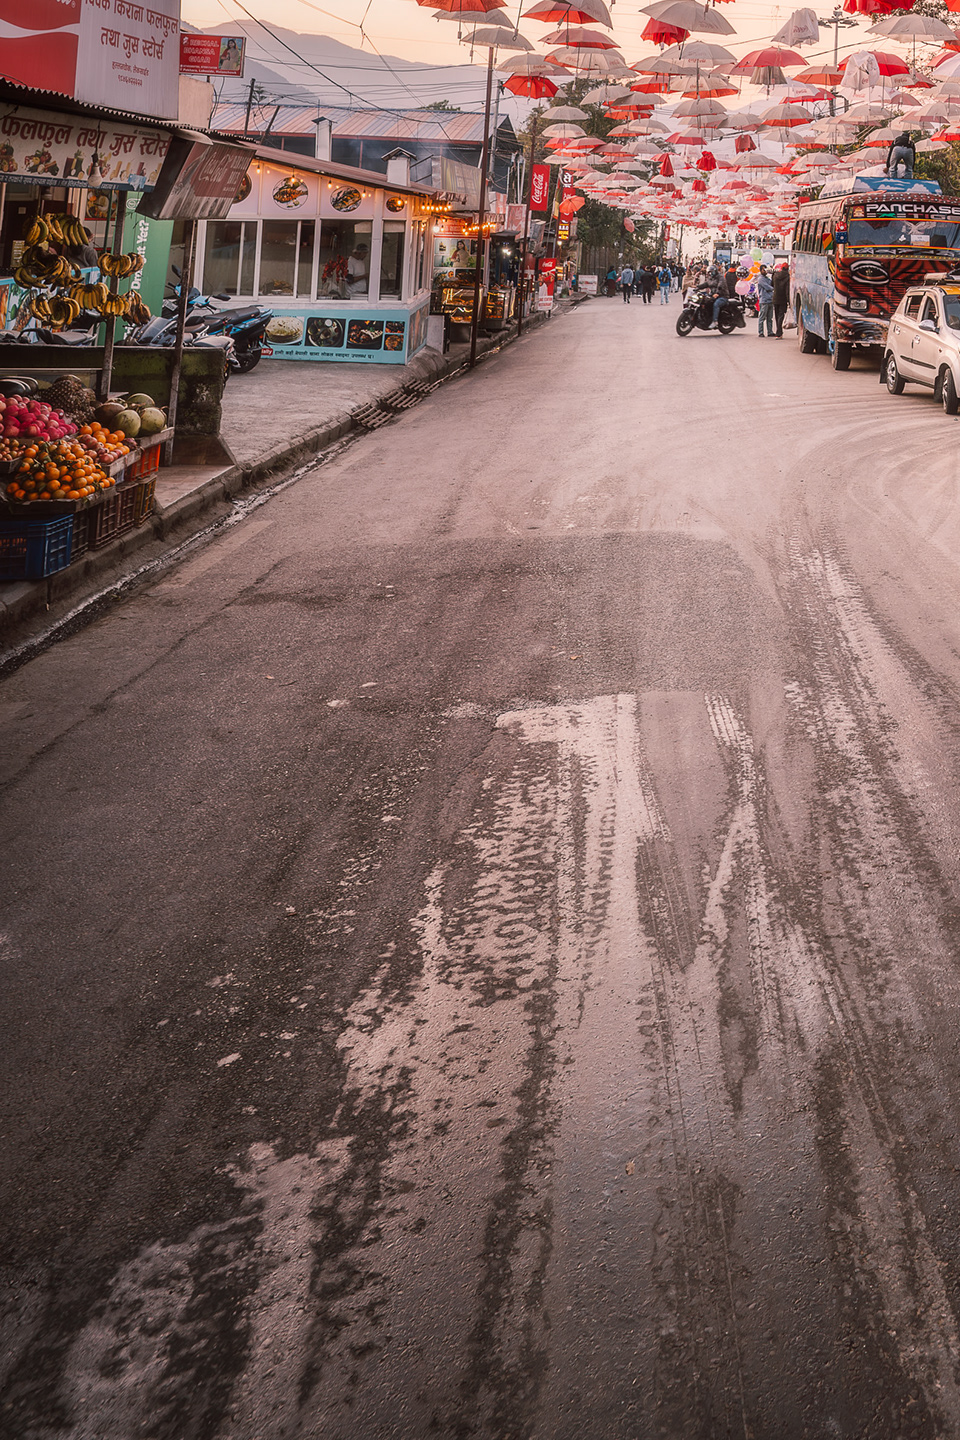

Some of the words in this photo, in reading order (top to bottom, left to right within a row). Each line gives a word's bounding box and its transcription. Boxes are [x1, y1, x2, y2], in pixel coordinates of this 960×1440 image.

[147, 9, 179, 38] फलफुल
[101, 27, 121, 48] तथा
[123, 33, 140, 58] जुस
[142, 36, 165, 60] स्टोर्स
[1, 116, 74, 147] फलफुल
[76, 127, 107, 148] तथा
[109, 133, 137, 156] जुस
[532, 172, 545, 203] Coca-Cola
[137, 220, 150, 244] Yet?
